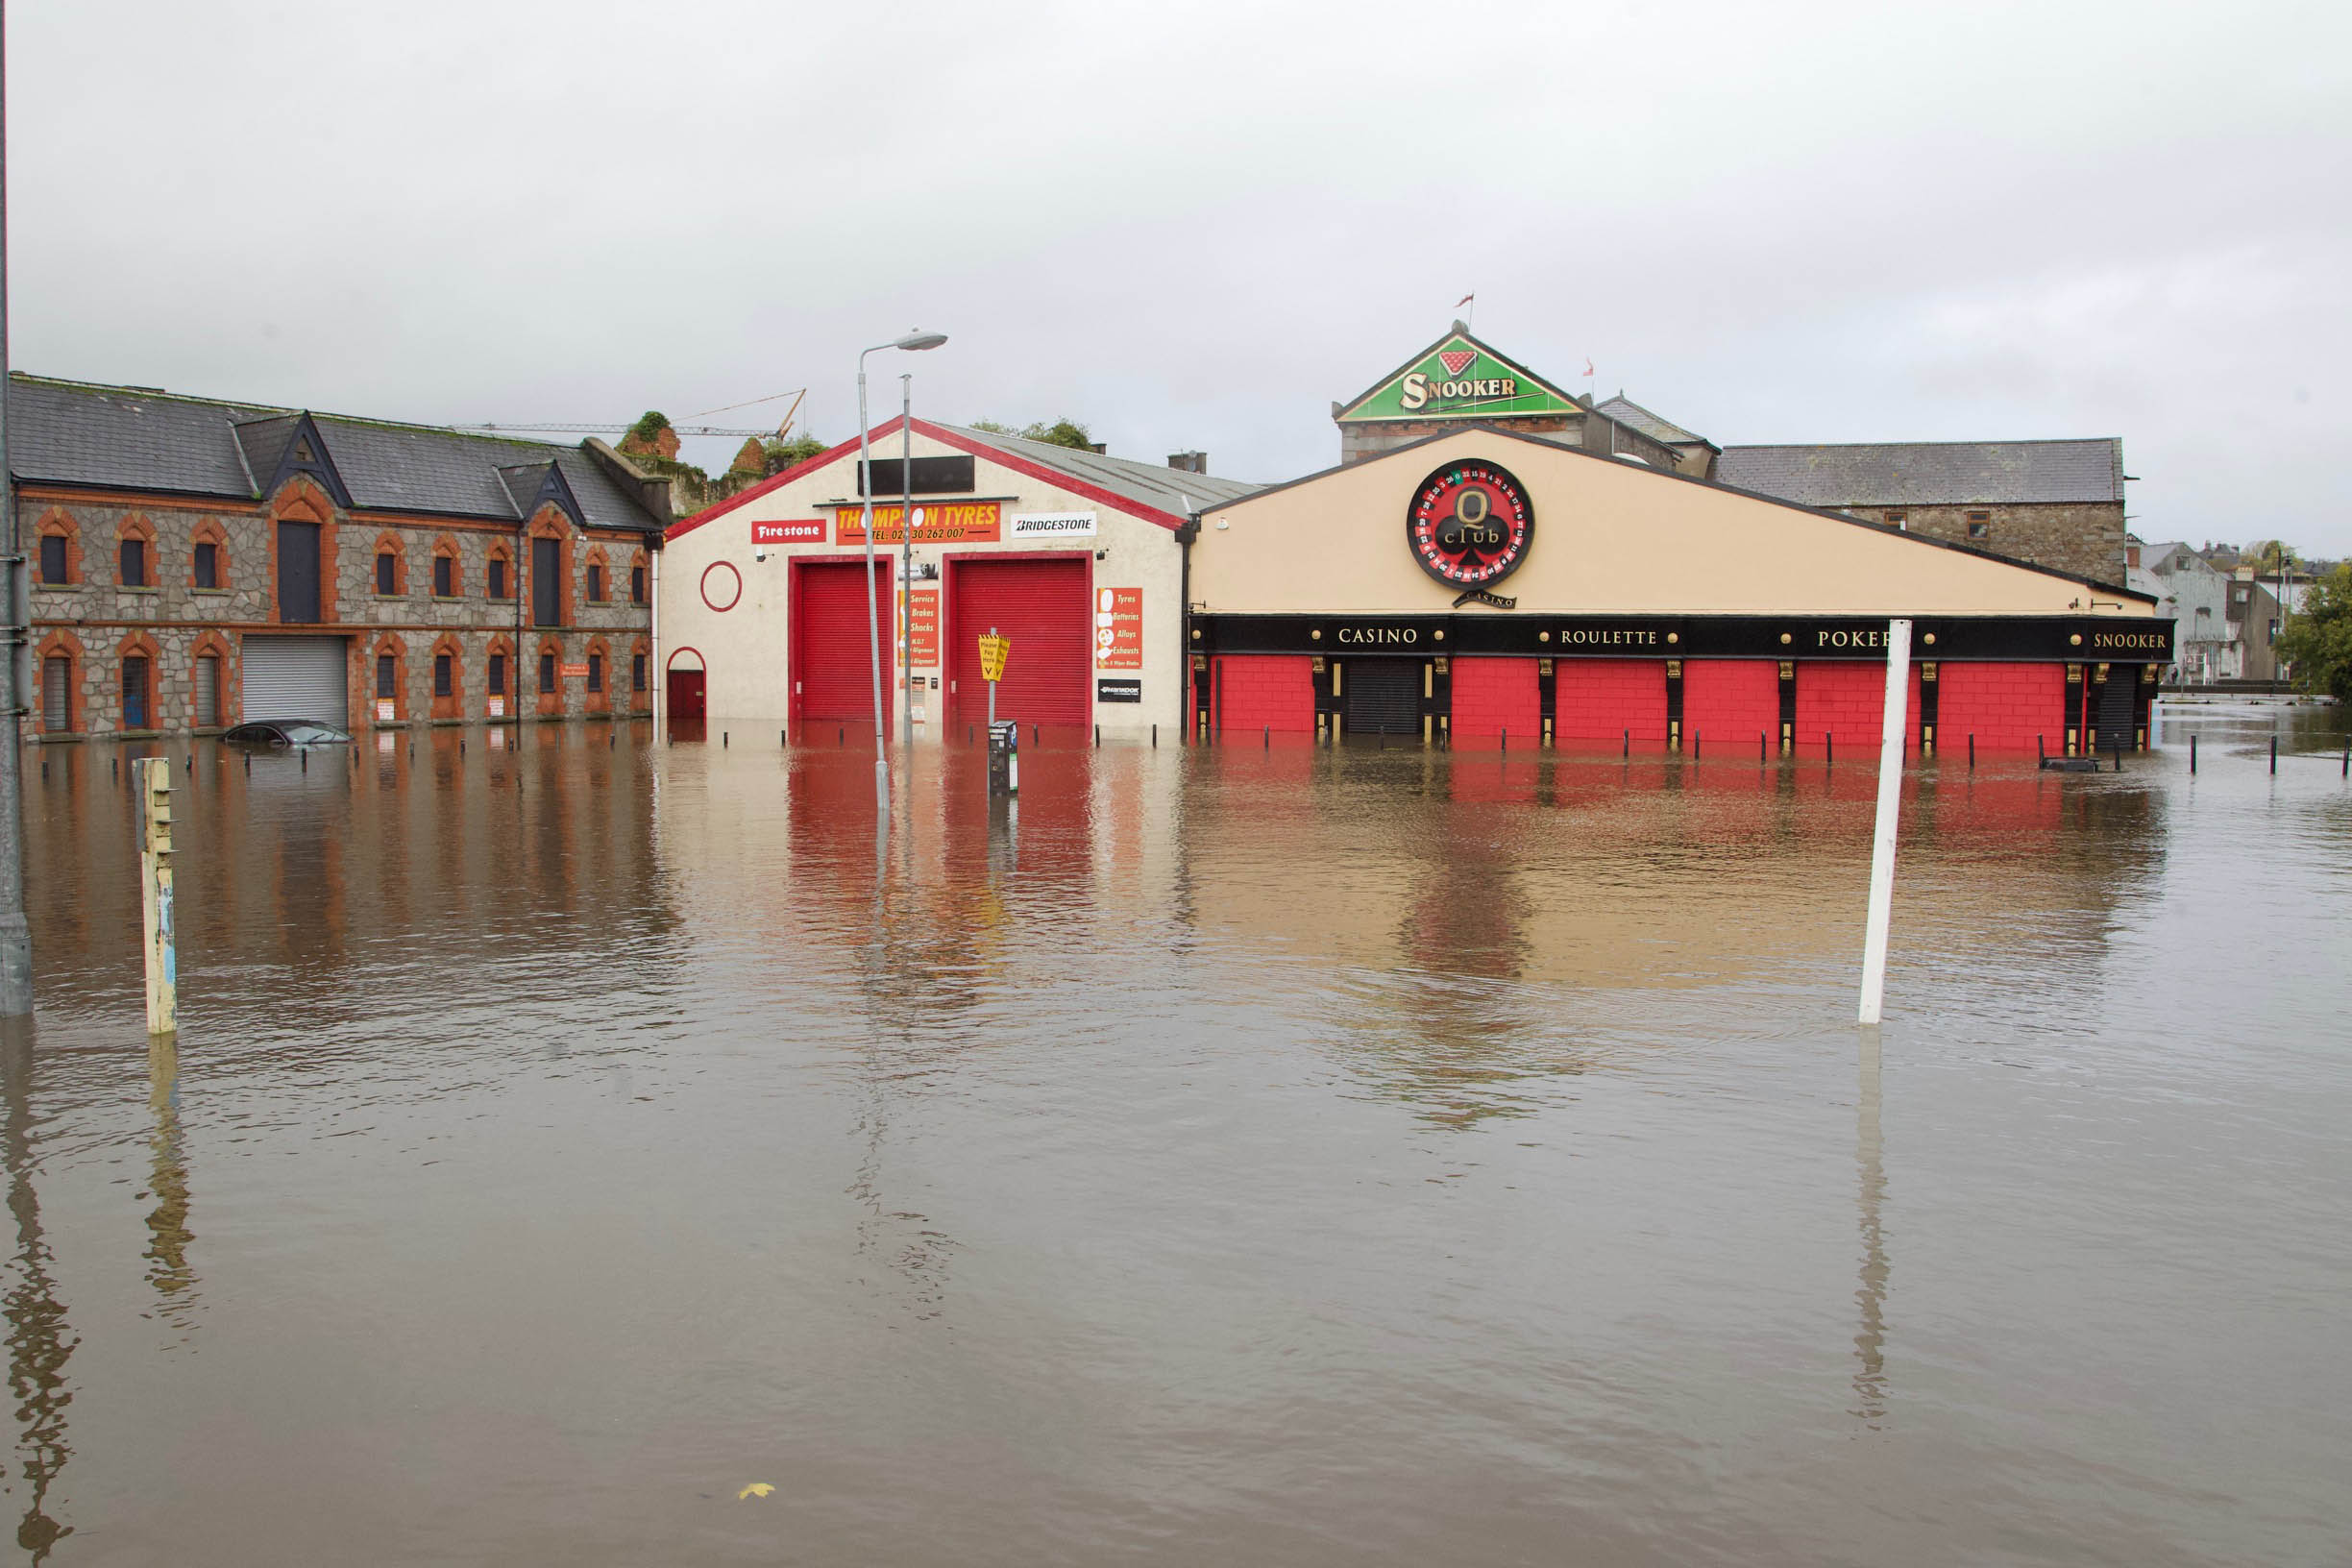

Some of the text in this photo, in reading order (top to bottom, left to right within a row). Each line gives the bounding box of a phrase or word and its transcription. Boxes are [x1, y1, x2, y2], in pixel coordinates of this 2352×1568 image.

[1400, 373, 1515, 408] SNOOKER
[944, 505, 996, 525] TYRES
[1457, 490, 1487, 528] Q
[1017, 520, 1091, 530] BRIDGESTONE
[758, 526, 819, 538] Firestone
[892, 529, 909, 540] 02
[912, 529, 922, 538] 30
[927, 529, 943, 538] 262
[947, 528, 965, 537] 007
[1445, 529, 1499, 543] club
[1118, 595, 1136, 604] Tyres
[912, 608, 934, 617] Brakes
[911, 623, 933, 631] Shocks
[1117, 630, 1136, 640] Alloys
[1338, 628, 1416, 643] CASINO
[1561, 630, 1656, 644] ROULETTE
[2095, 633, 2166, 648] SNOOKER
